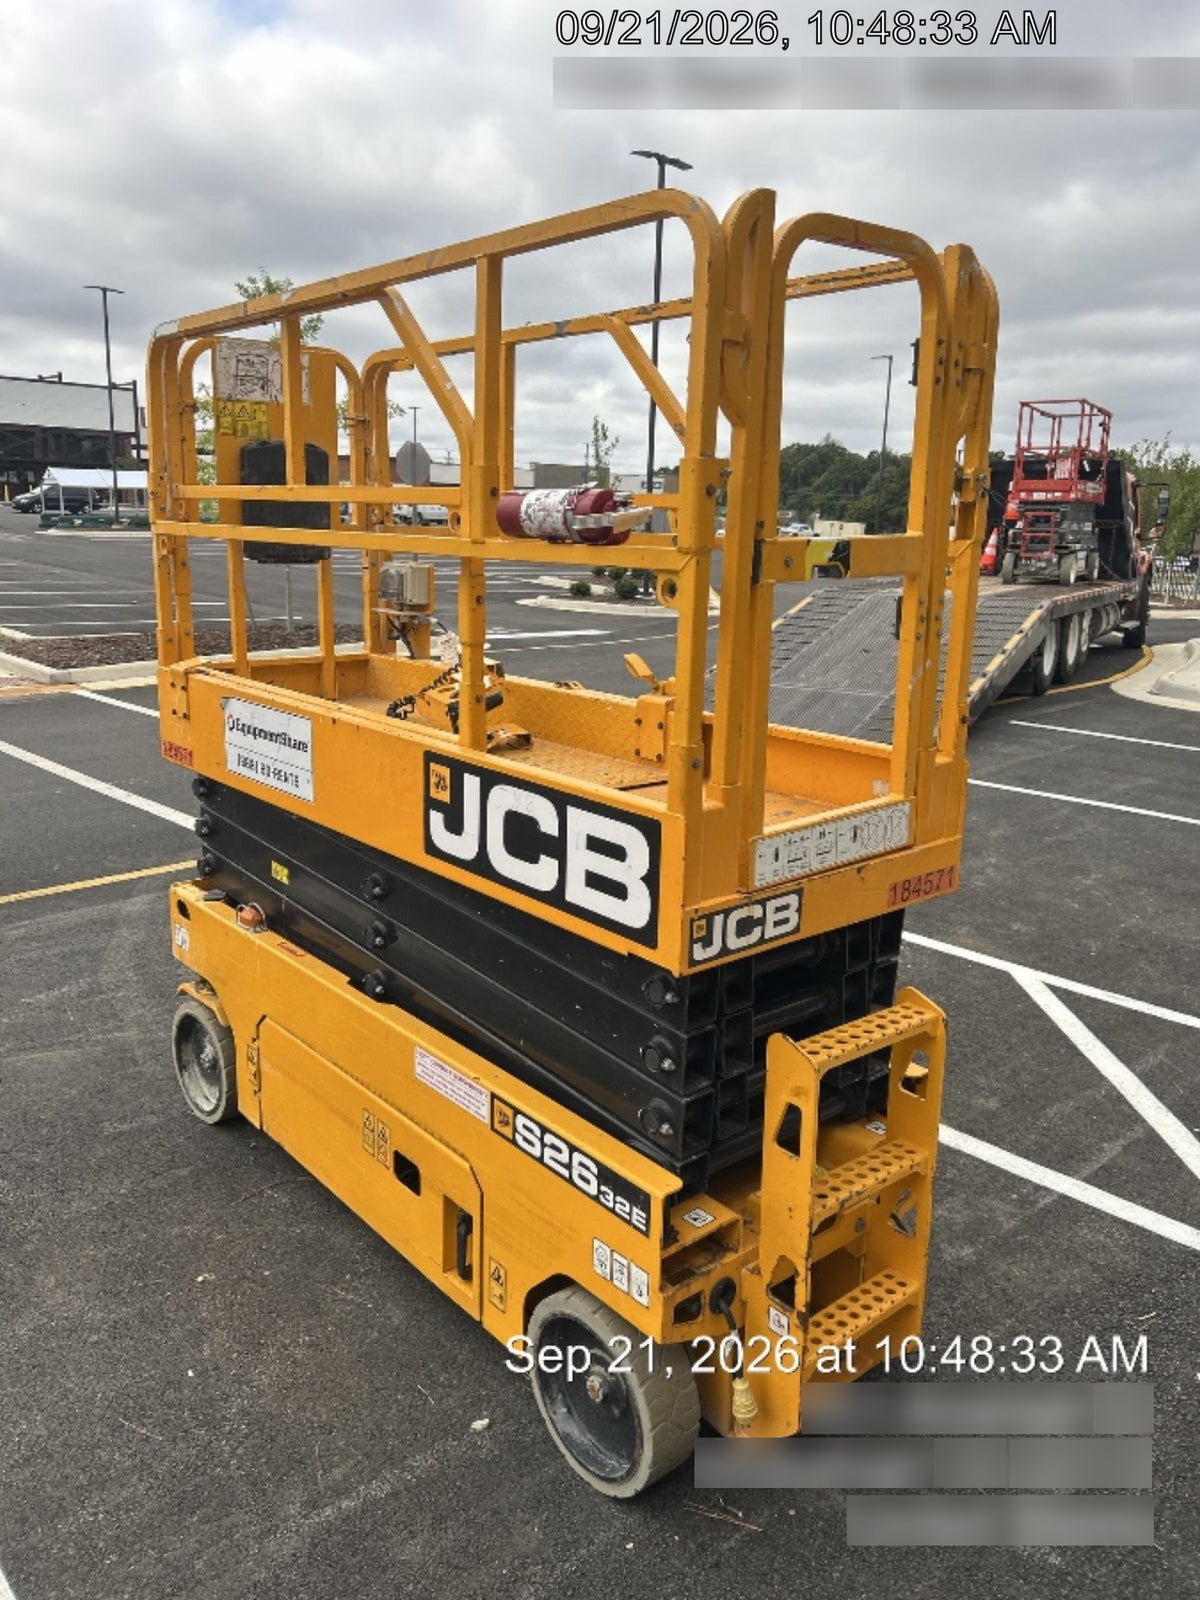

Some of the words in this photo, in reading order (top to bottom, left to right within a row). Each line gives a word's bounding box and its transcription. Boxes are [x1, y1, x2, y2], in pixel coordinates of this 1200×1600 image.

[430, 773, 652, 929] JCB
[889, 866, 956, 906] 184571
[693, 893, 799, 961] JCB
